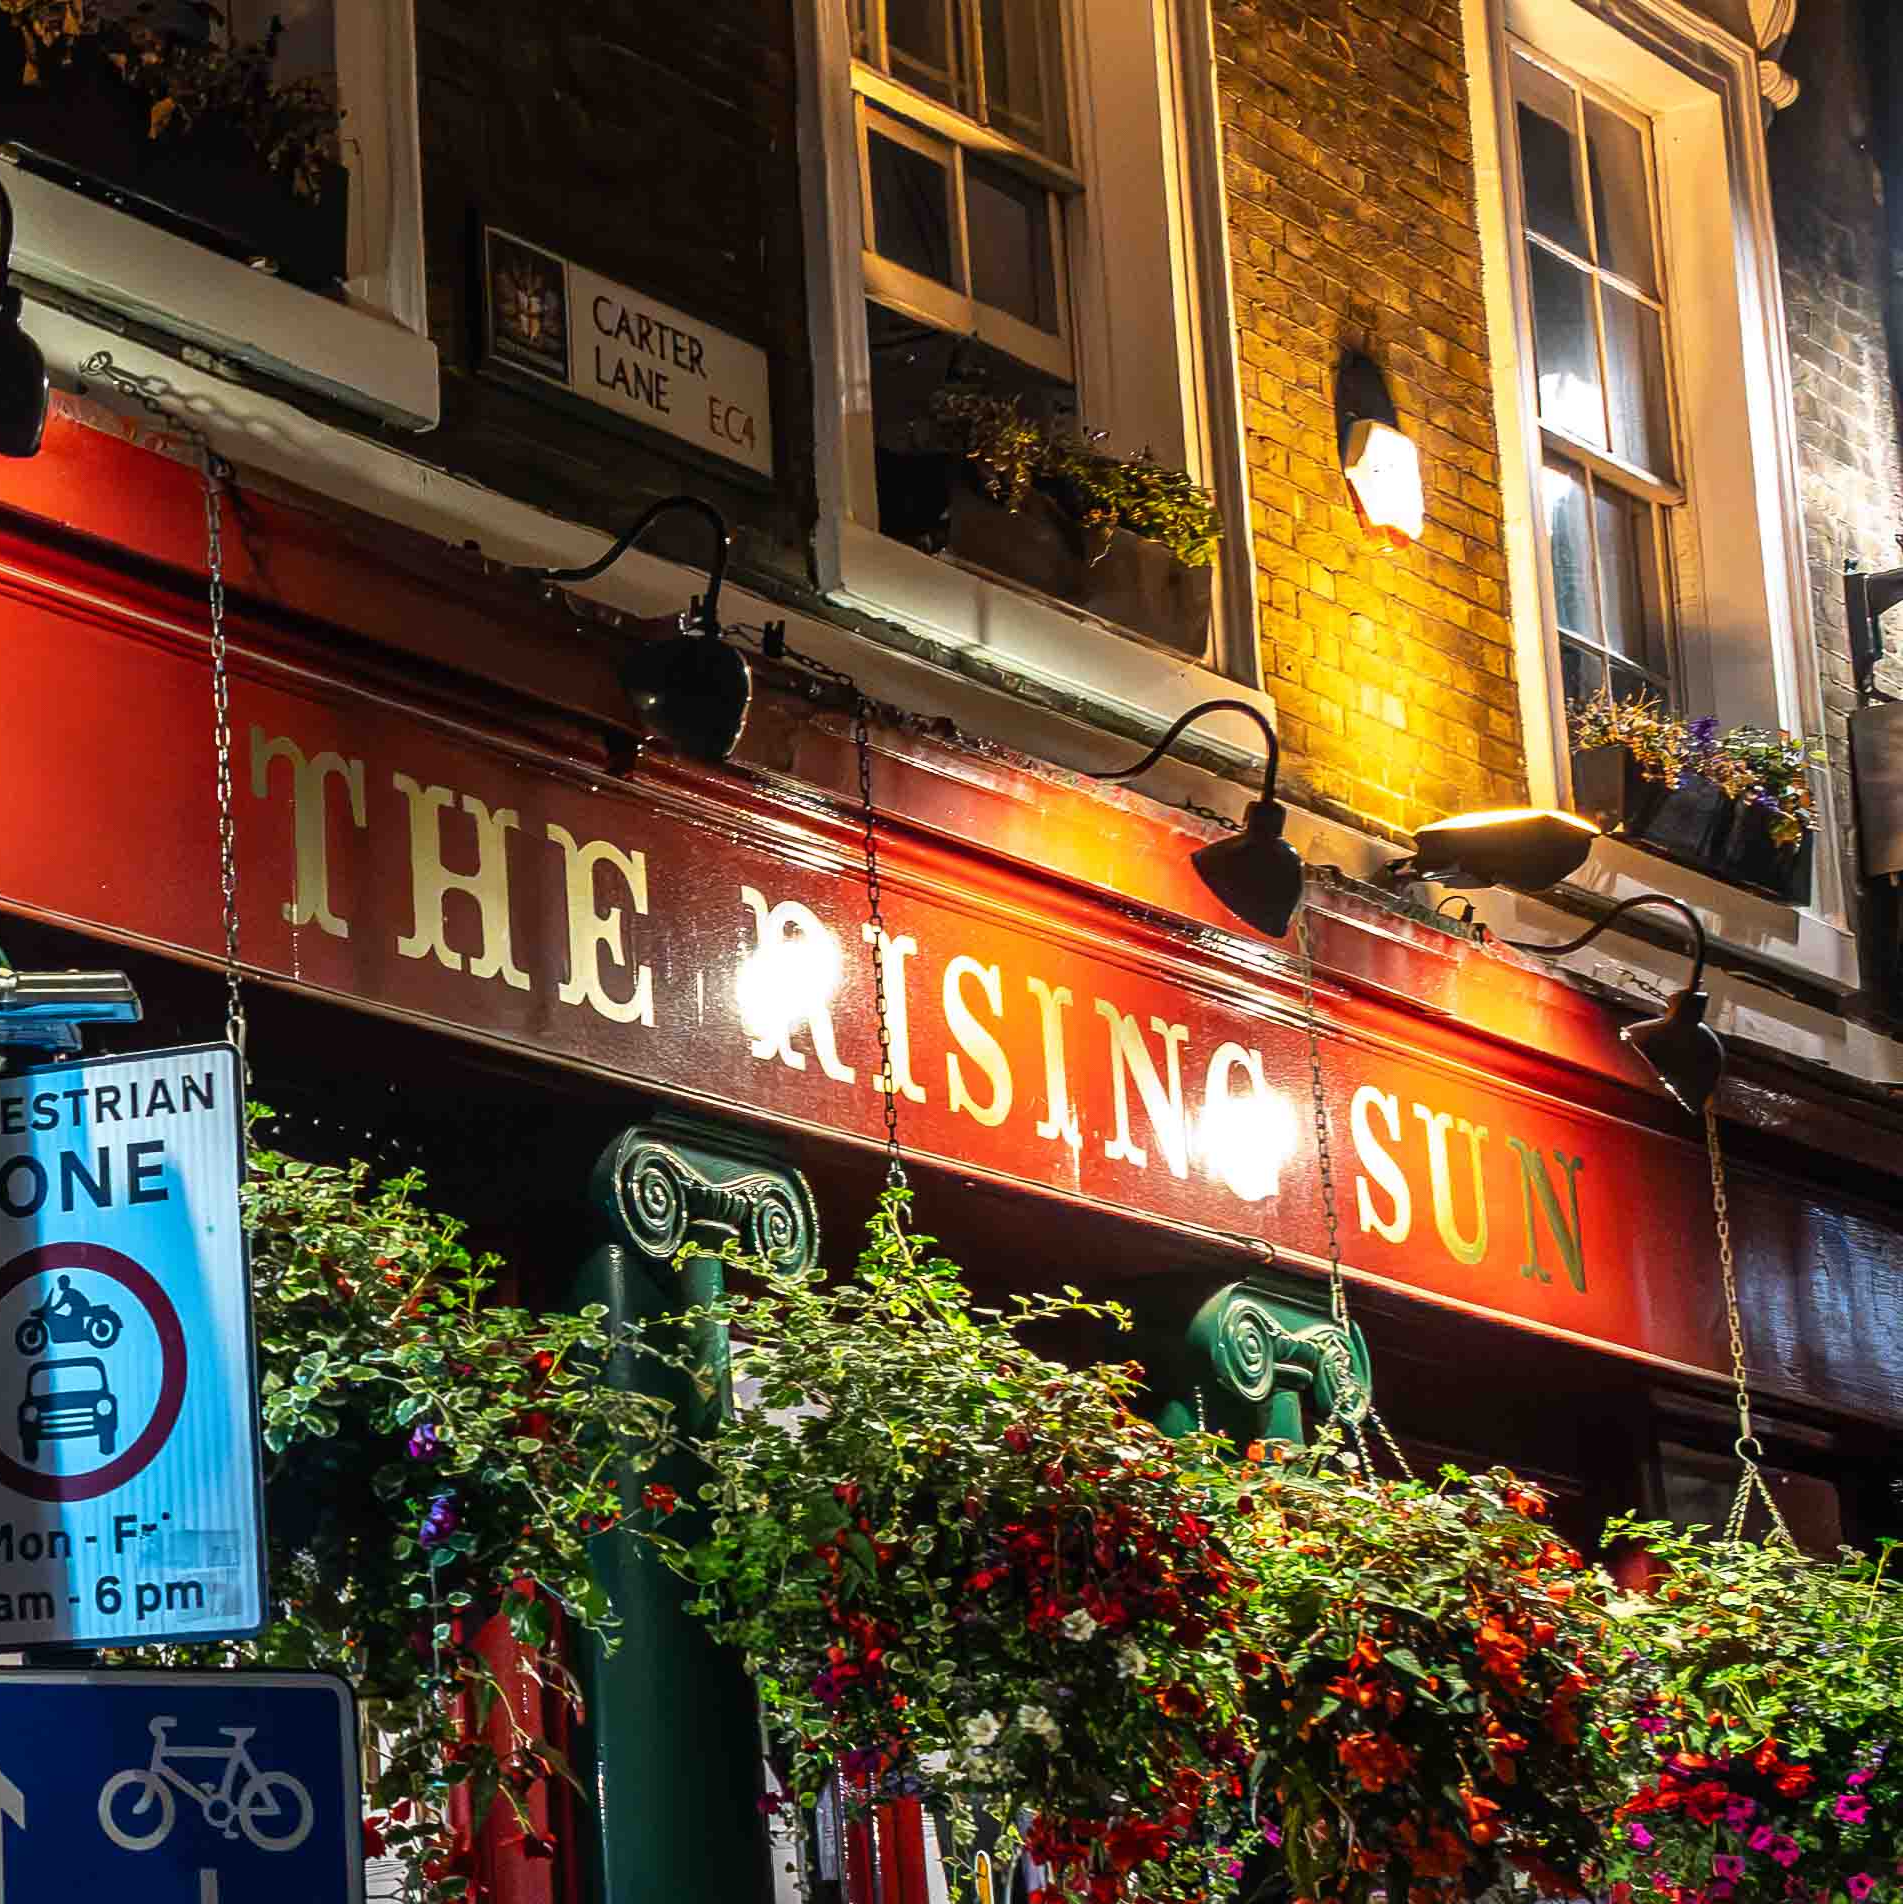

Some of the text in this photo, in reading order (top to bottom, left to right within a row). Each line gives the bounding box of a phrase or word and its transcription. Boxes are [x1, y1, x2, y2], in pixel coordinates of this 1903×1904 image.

[592, 295, 707, 379] CARTER
[594, 345, 670, 415] LANE
[707, 395, 756, 450] EC4
[249, 722, 1587, 1293] THE RISING SUN
[95, 1575, 123, 1615] 6
[135, 1579, 205, 1621] pm
